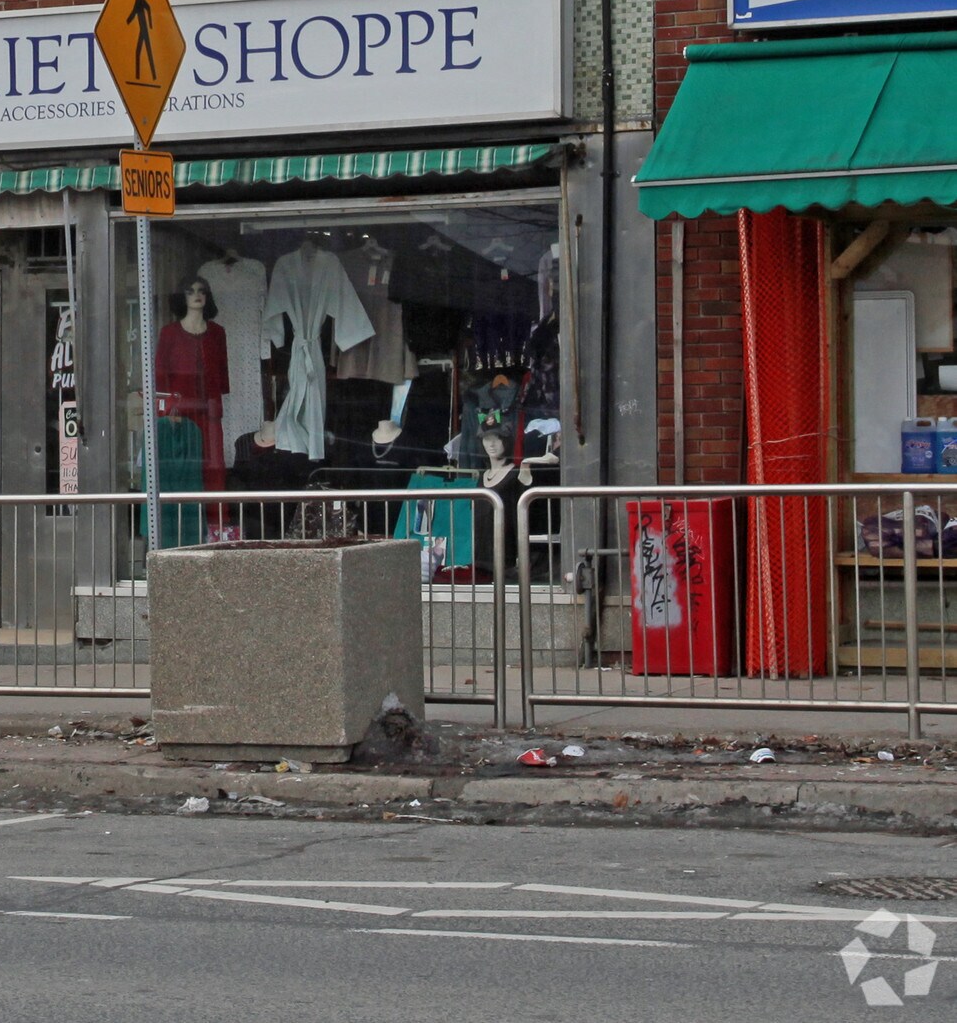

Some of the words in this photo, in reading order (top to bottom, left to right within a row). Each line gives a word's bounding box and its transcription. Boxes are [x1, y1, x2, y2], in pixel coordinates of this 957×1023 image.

[192, 6, 483, 87] SHOPPE
[0, 99, 116, 122] ACCESSORIES
[124, 167, 171, 200] SENIORS
